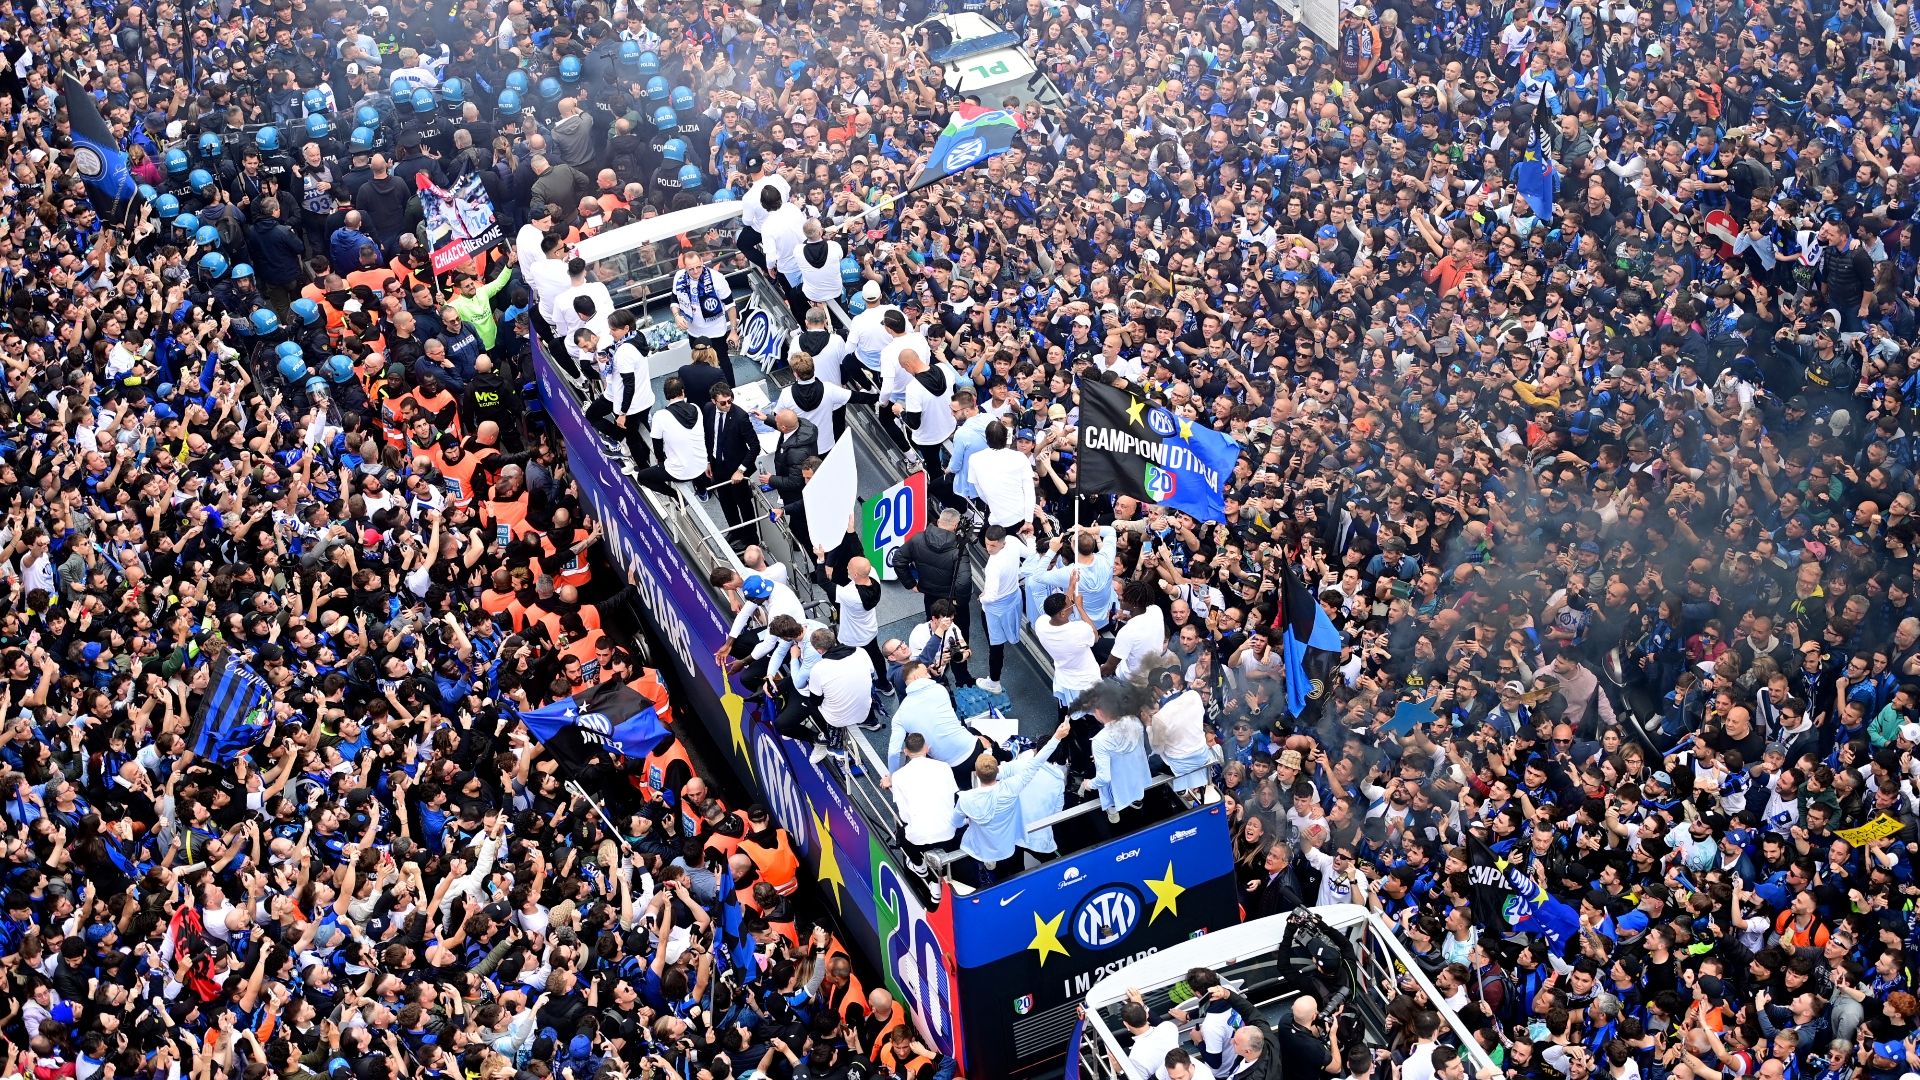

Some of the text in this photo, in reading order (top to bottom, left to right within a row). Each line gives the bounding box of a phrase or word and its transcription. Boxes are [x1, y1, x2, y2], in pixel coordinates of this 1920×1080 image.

[170, 157, 187, 166] POLIZIA
[163, 203, 179, 211] POLIZIA
[310, 197, 330, 212] 03
[434, 225, 502, 269] CHIACCHIERONE
[475, 391, 499, 402] MKS
[1085, 426, 1168, 466] CAMPIONI
[1149, 467, 1173, 492] 20
[874, 486, 913, 551] 20
[580, 730, 624, 754] INTER
[1115, 848, 1141, 862] ebay
[1016, 996, 1032, 1012] 20
